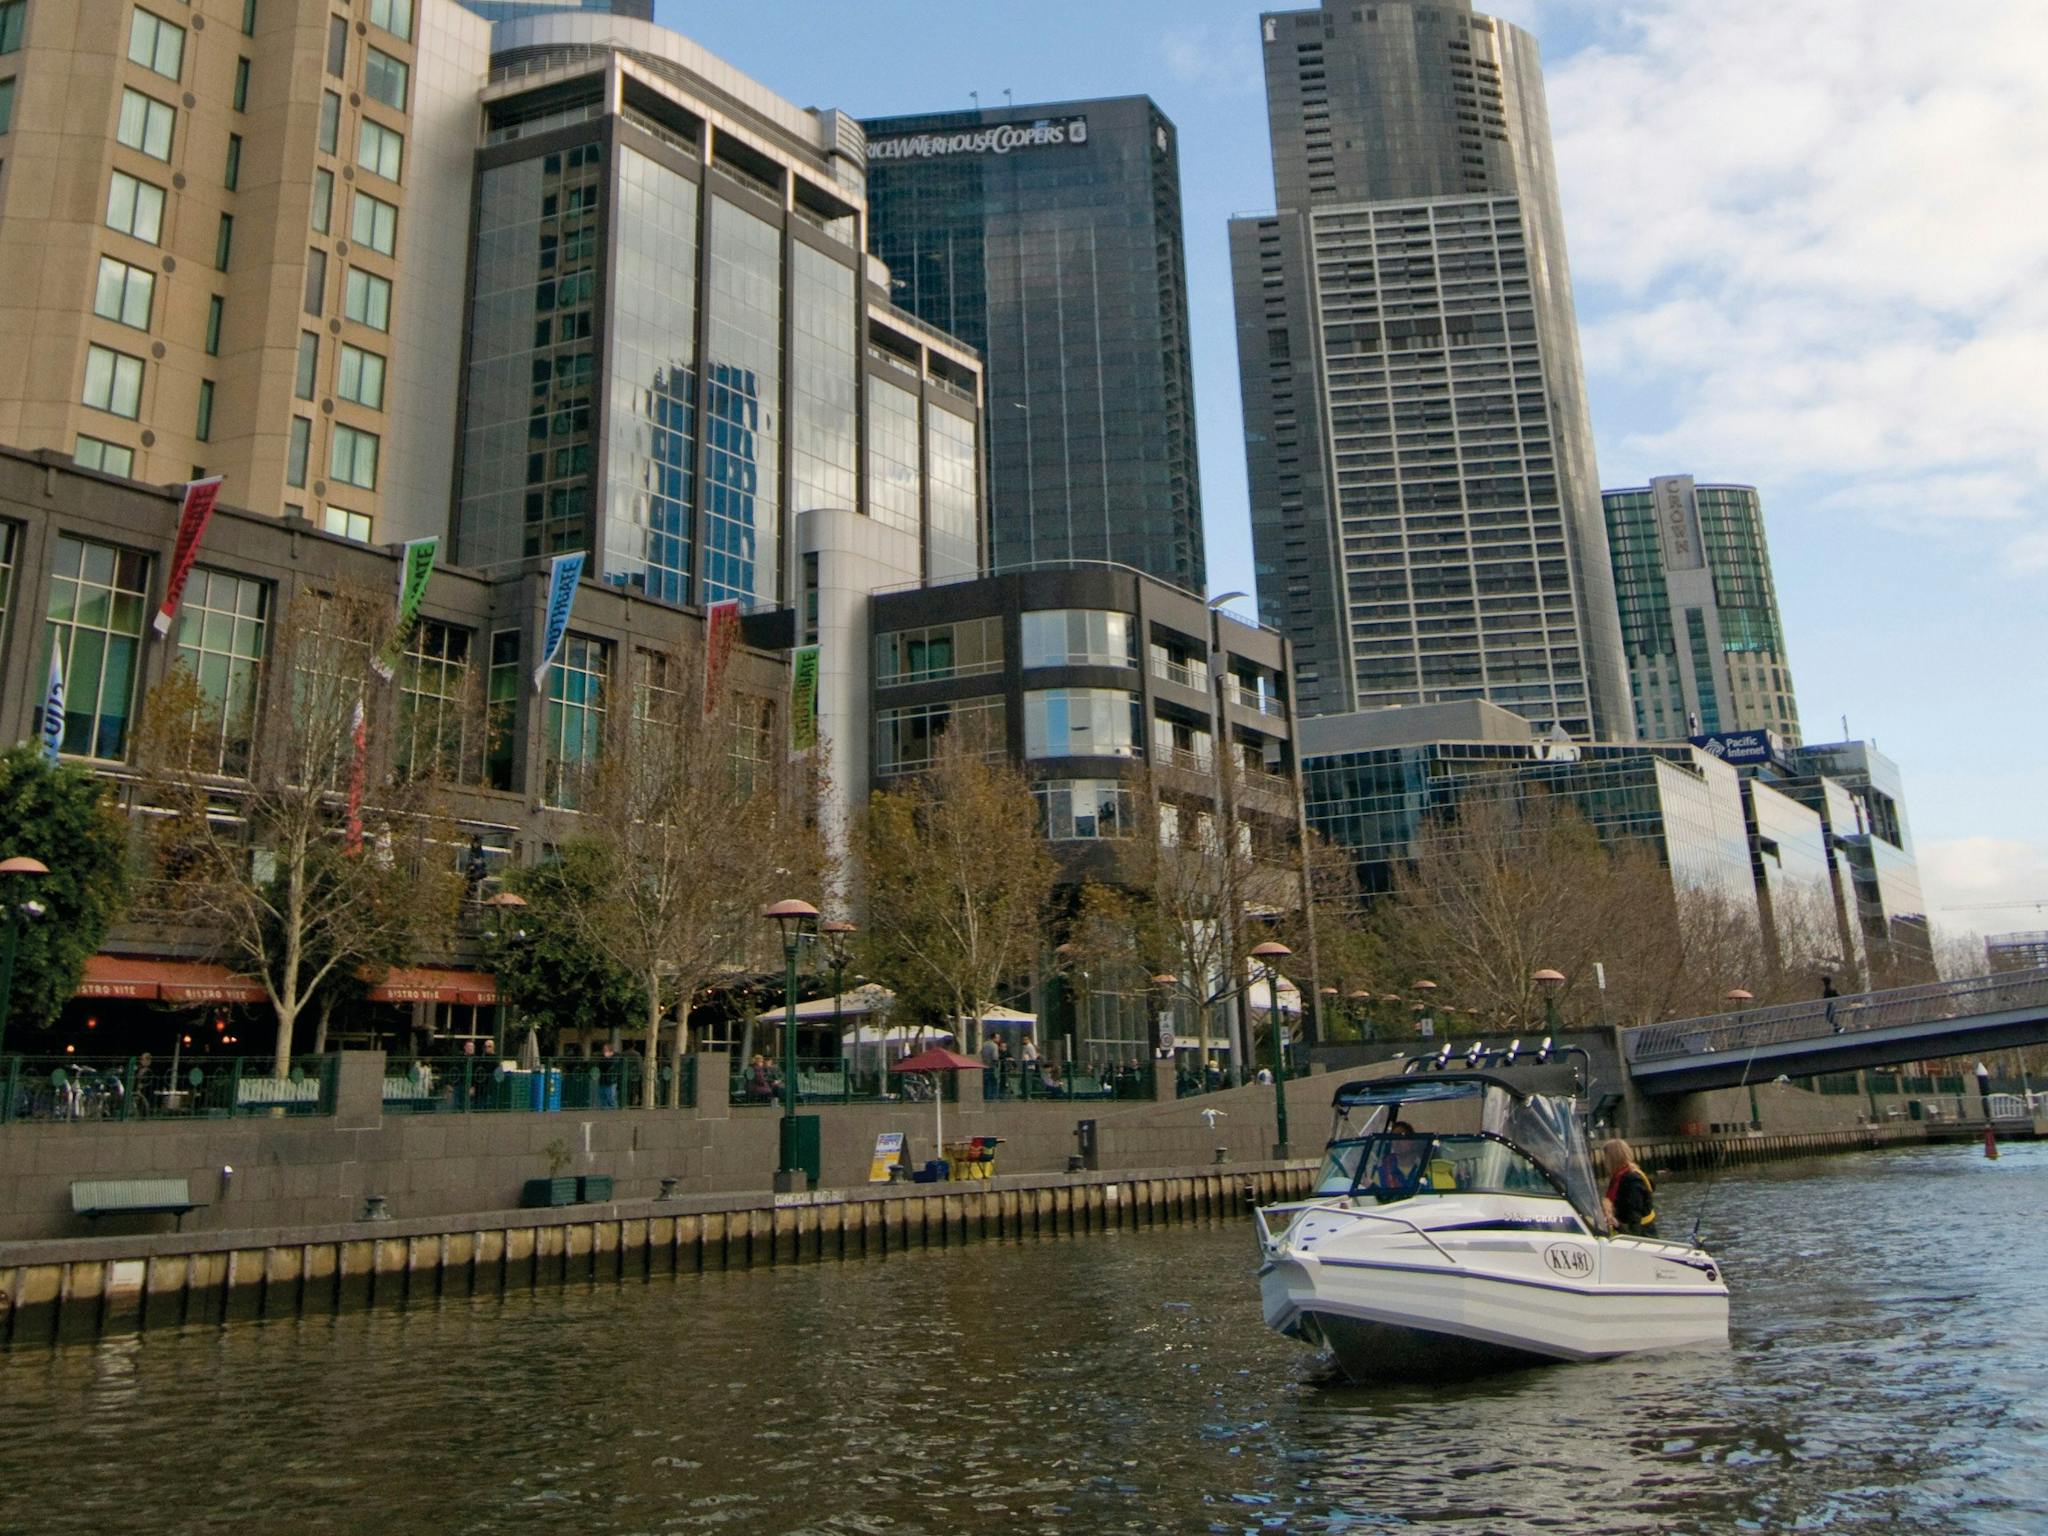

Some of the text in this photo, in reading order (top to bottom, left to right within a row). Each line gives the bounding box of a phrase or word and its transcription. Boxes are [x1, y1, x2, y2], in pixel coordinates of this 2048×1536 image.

[865, 125, 1065, 158] RICEWATERHOUSECOOPERS
[1665, 480, 1690, 555] CROWN
[1726, 736, 1758, 748] Pacific
[1727, 745, 1766, 758] Internet
[77, 985, 111, 995] ISTRO
